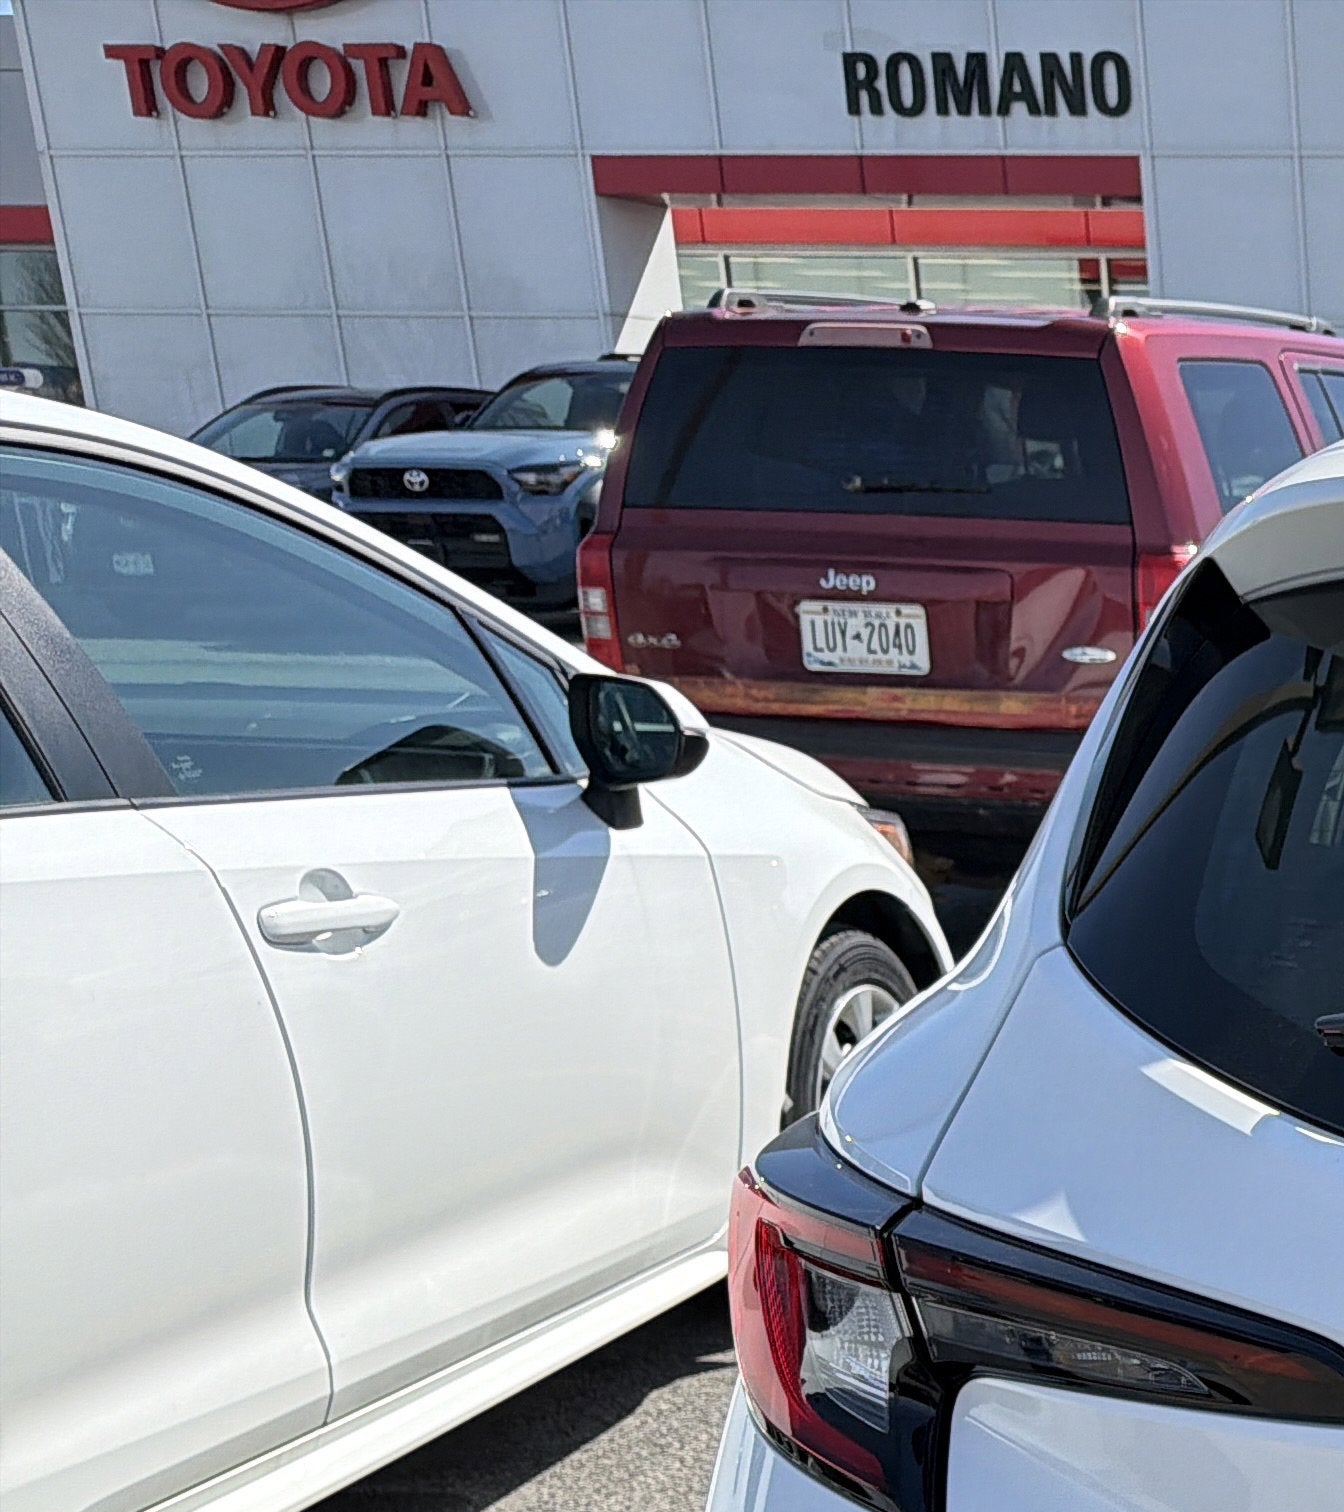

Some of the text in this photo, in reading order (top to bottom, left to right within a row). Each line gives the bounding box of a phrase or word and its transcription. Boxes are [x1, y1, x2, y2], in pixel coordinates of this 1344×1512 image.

[103, 41, 478, 119] TOYOTA
[841, 51, 1132, 118] ROMANO
[819, 568, 876, 595] Jeep
[810, 619, 916, 656] LUY 2040
